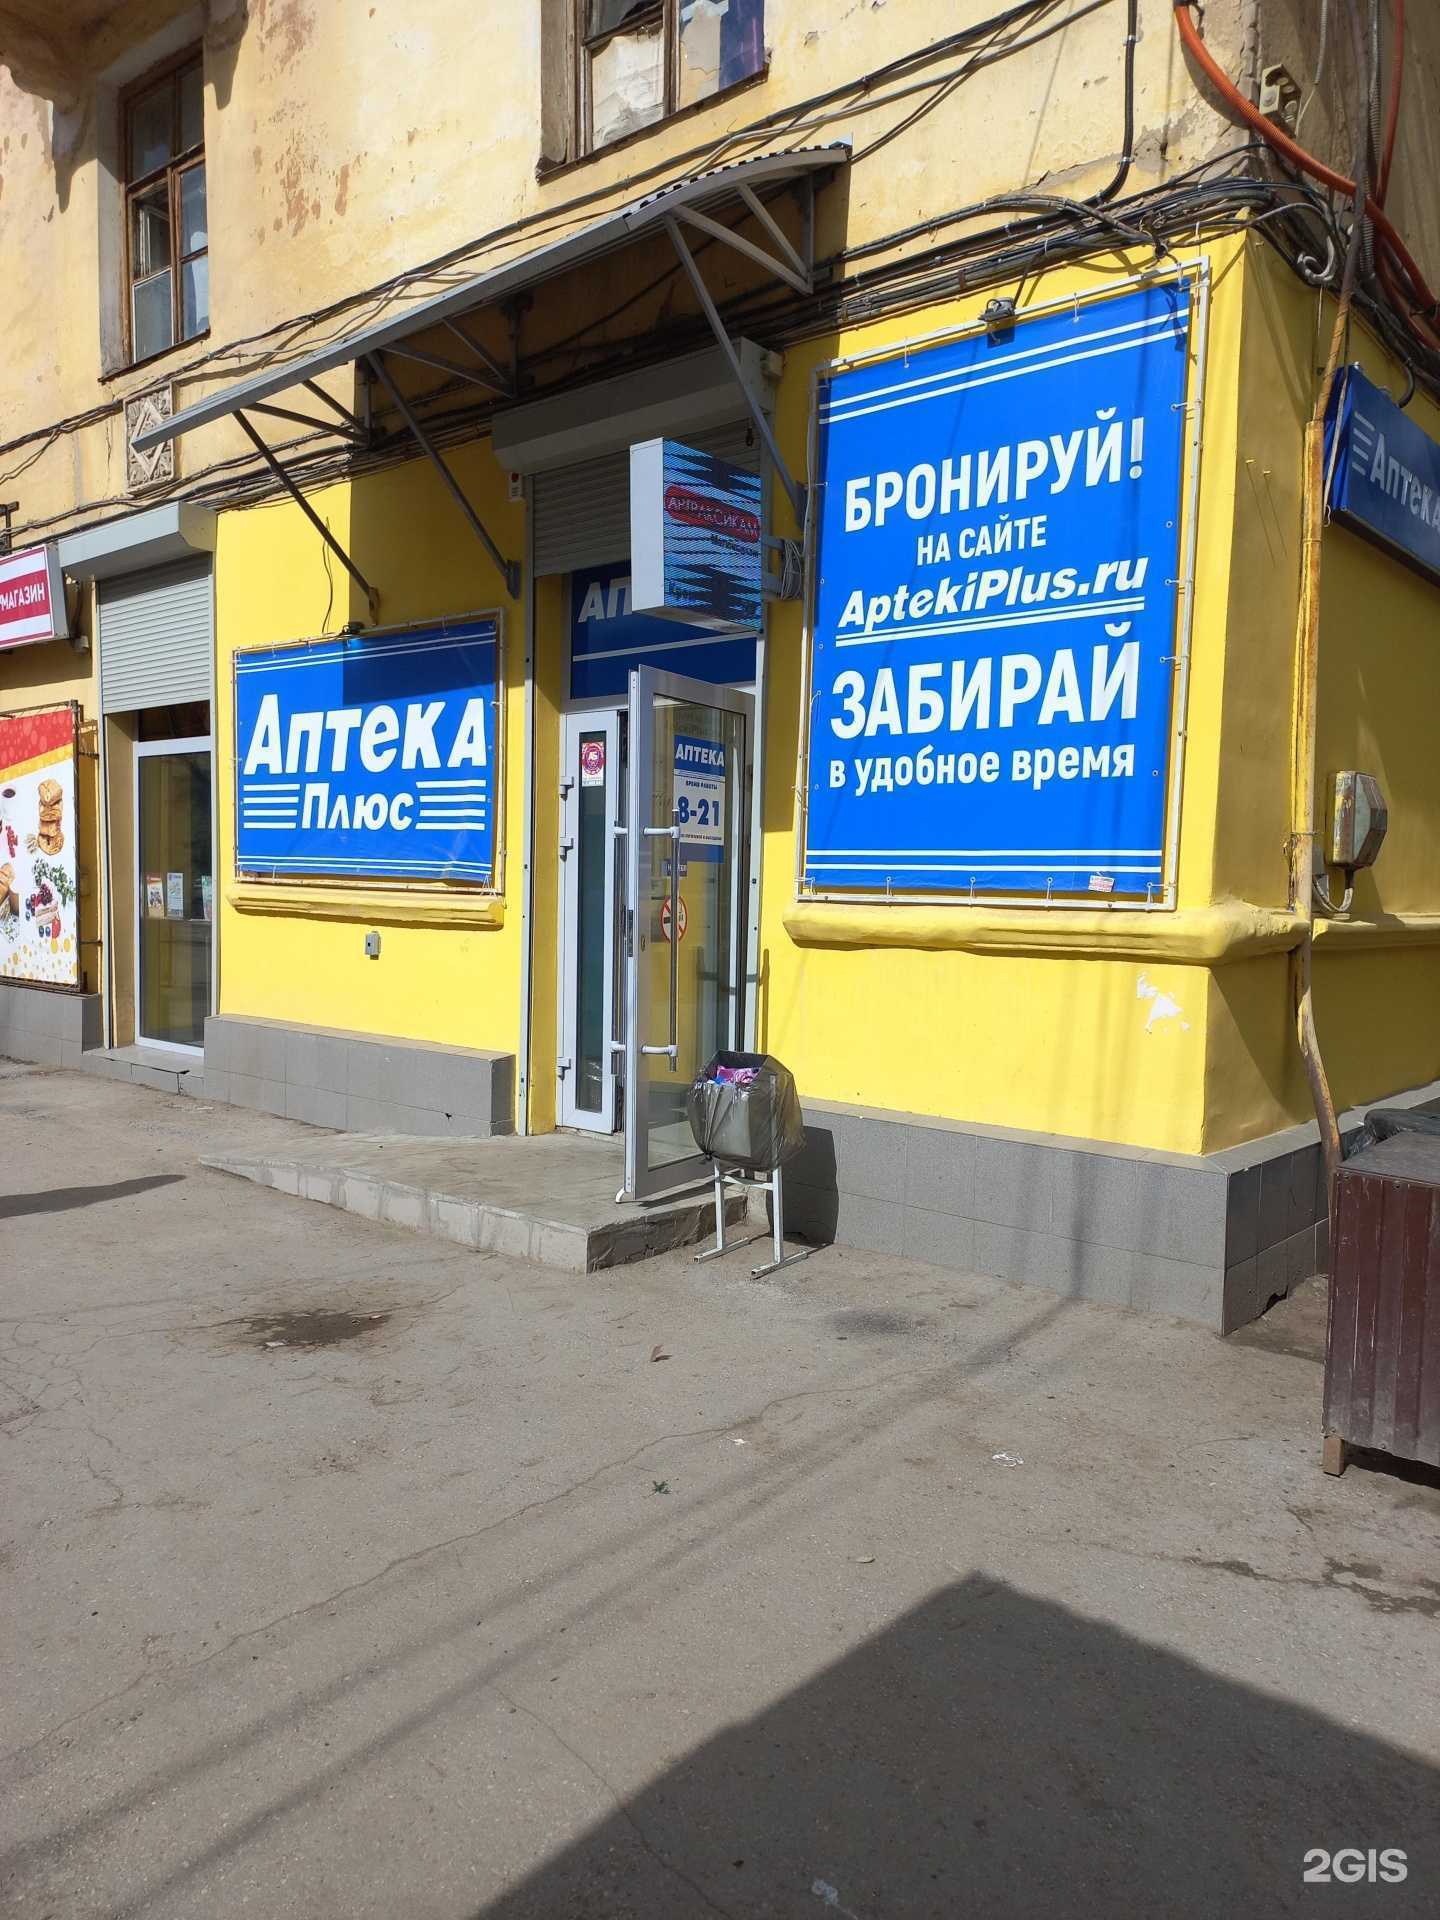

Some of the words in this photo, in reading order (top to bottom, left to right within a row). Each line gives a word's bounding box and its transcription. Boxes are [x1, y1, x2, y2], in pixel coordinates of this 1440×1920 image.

[844, 407, 1144, 533] БРОНИРУЙ!
[916, 532, 951, 566] НА
[958, 513, 1047, 559] САЙТЕ
[837, 556, 1149, 632] AptekiPlus.ru
[830, 621, 1140, 739] ЗАБИРАЙ
[243, 694, 487, 775] Аптека
[675, 744, 725, 767] АПТЕКА
[829, 759, 846, 788] в
[855, 744, 1000, 796] удобное
[1011, 743, 1135, 790] время
[301, 782, 414, 830] Плюс
[678, 796, 720, 827] 8-21
